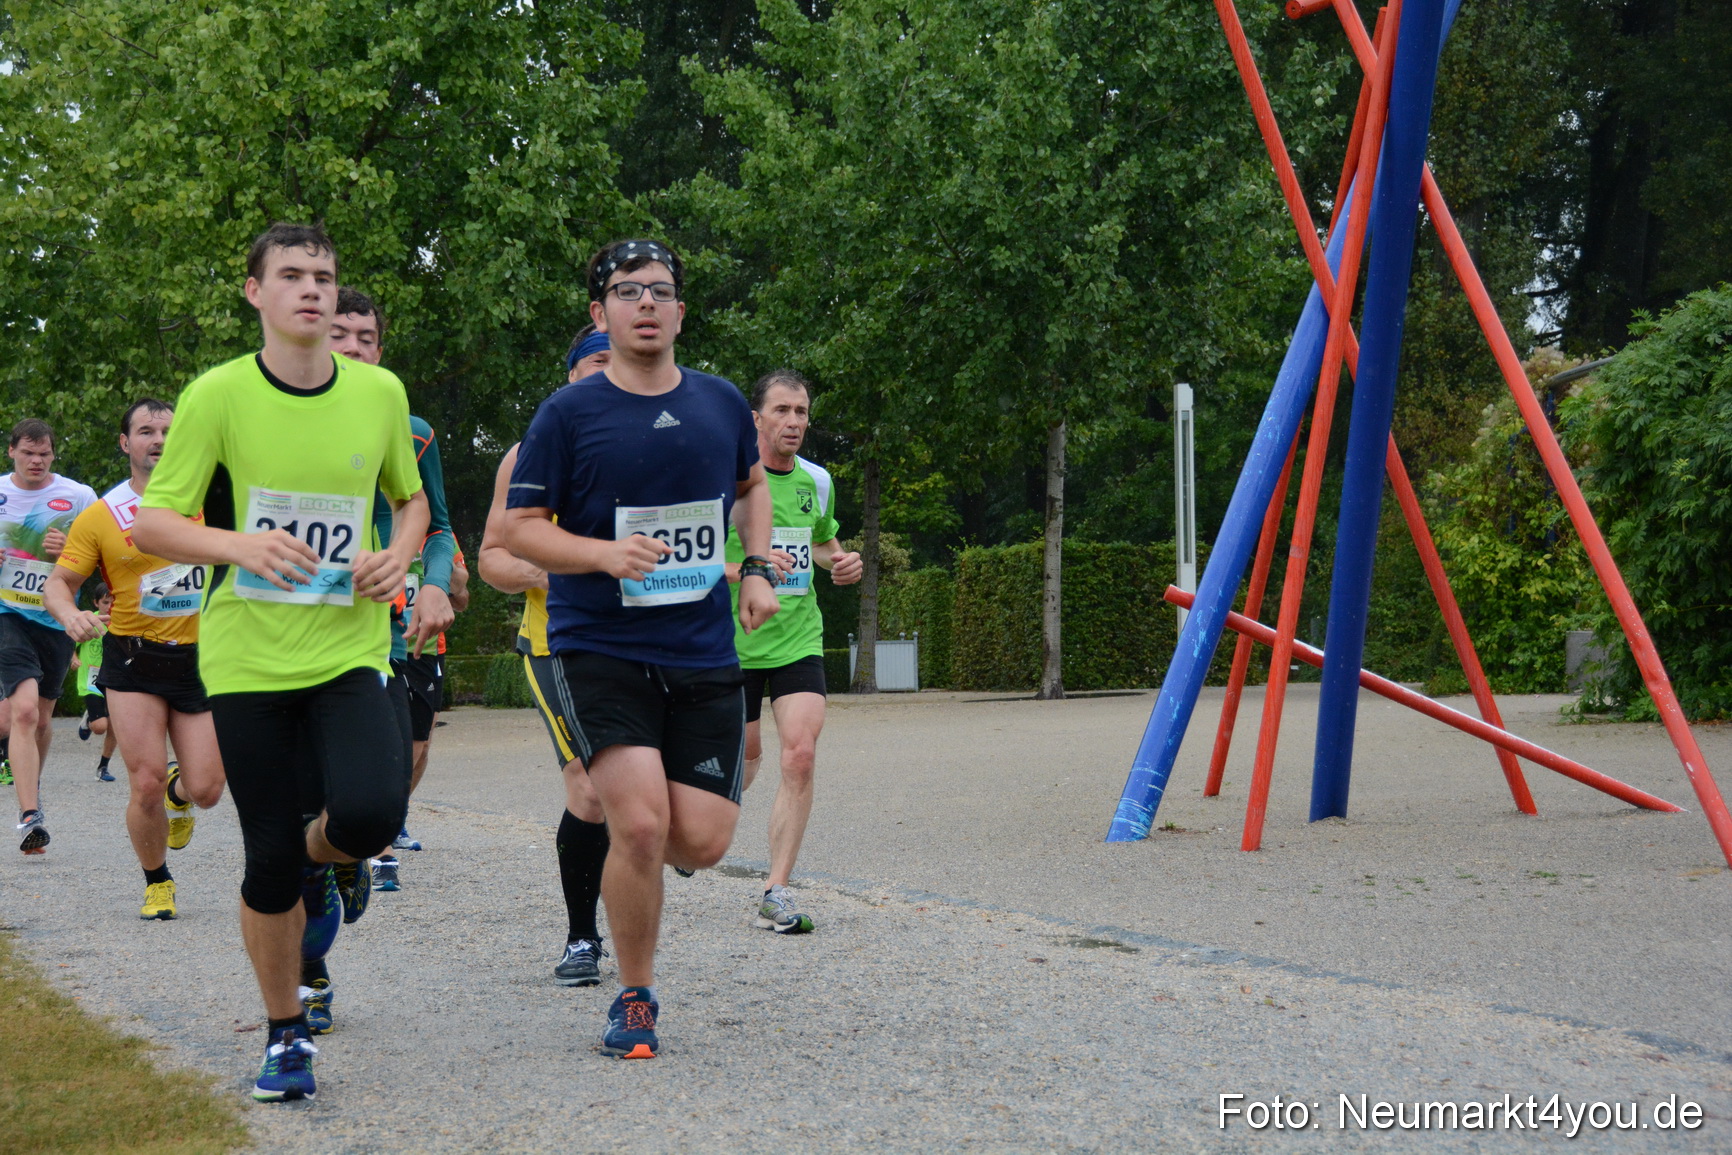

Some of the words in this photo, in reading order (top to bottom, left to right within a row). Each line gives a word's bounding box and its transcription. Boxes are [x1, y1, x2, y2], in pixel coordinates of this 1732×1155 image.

[653, 420, 680, 428] adidas
[299, 497, 355, 514] BOCK
[665, 504, 715, 519] BOCK
[631, 525, 715, 565] 659
[771, 545, 809, 569] 53
[643, 572, 706, 591] Christoph
[15, 594, 41, 605] Tobias
[161, 599, 192, 610] Marco
[694, 765, 724, 778] adidas
